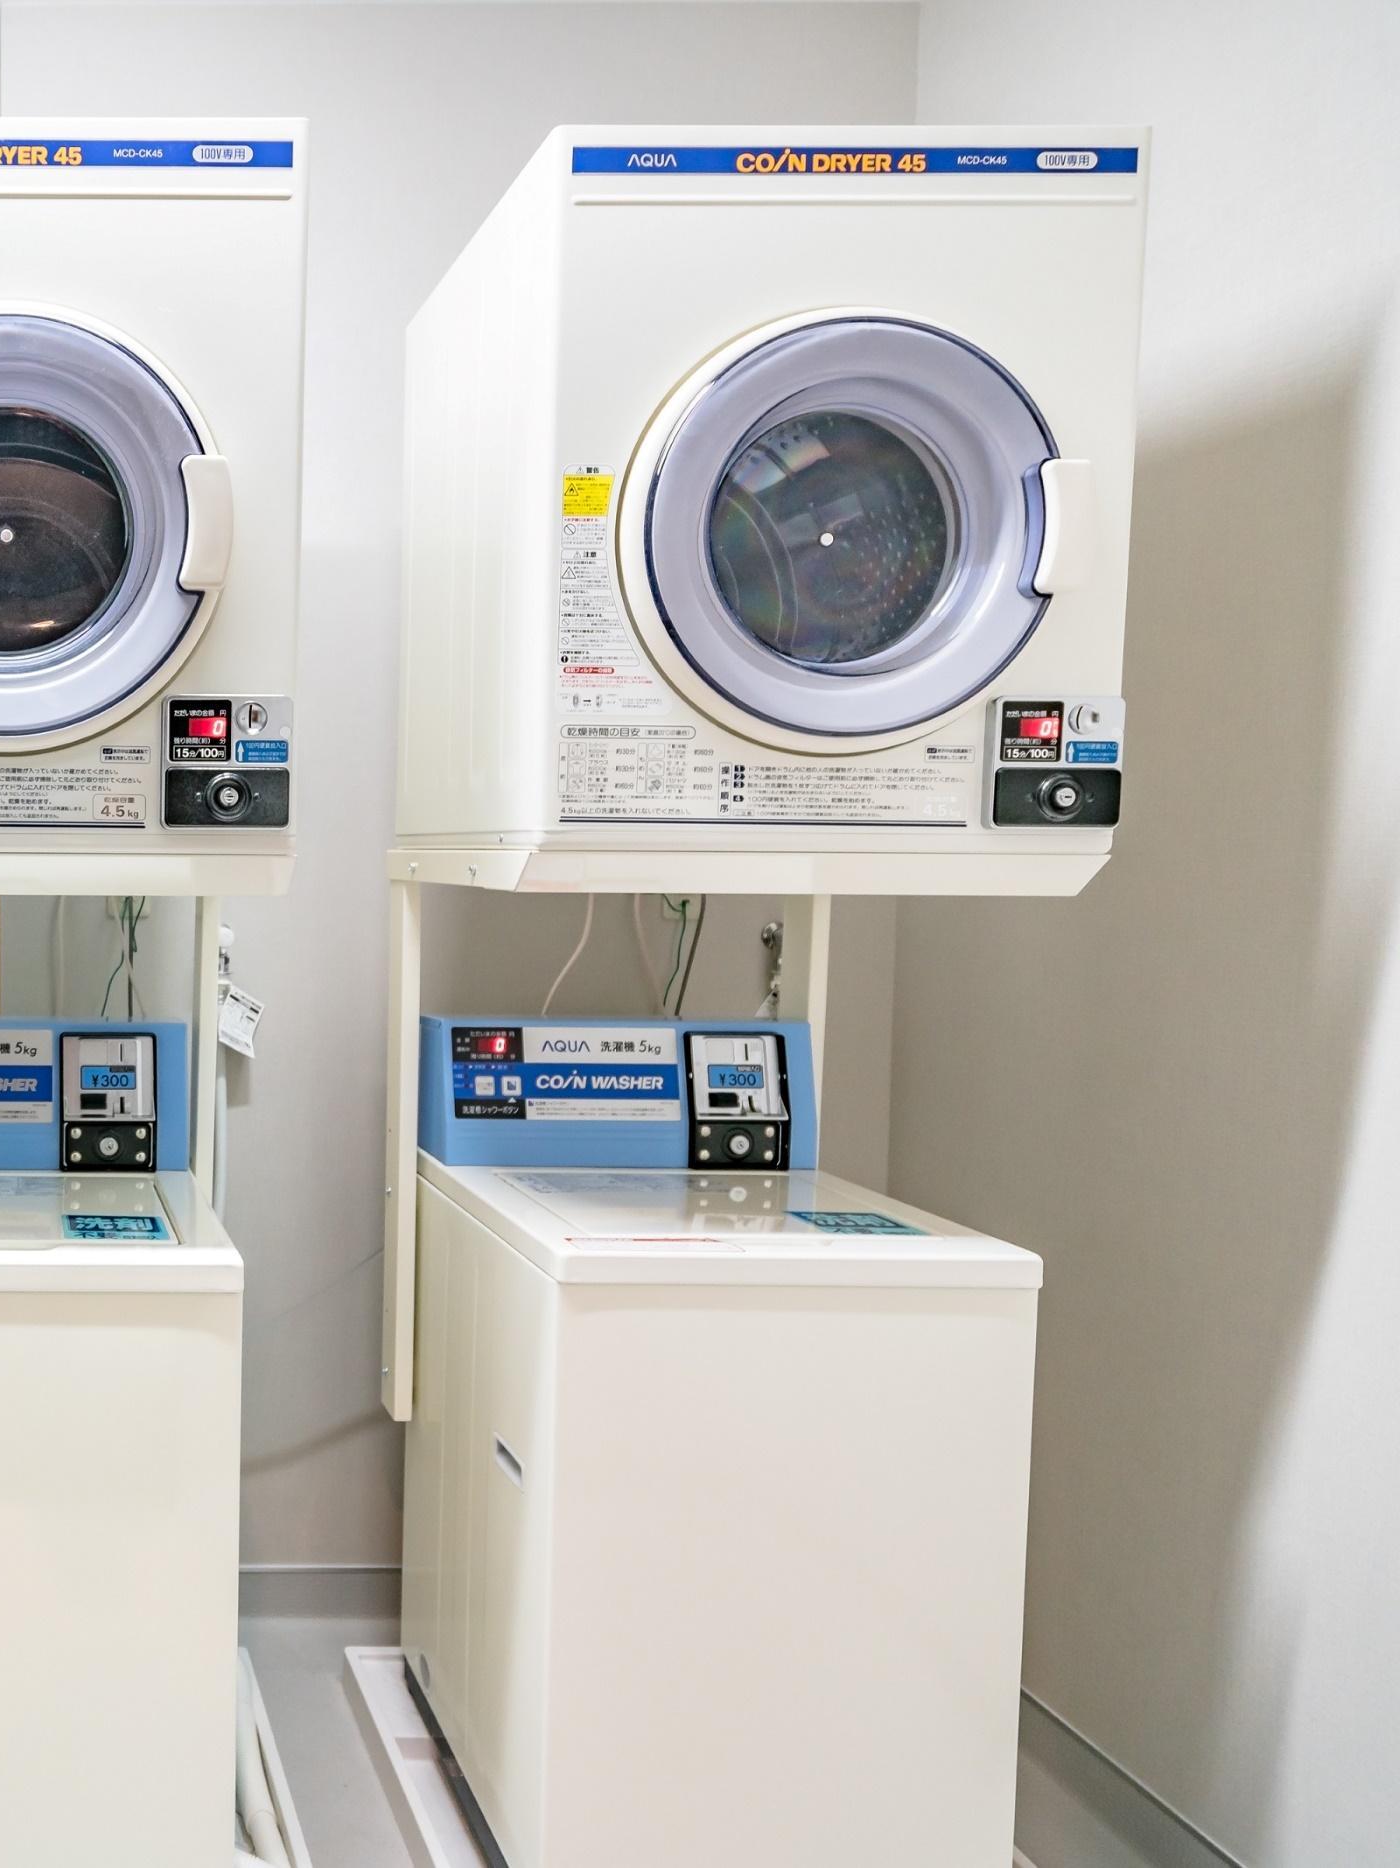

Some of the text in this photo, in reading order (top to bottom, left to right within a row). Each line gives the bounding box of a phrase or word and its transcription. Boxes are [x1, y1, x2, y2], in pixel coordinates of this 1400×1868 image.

[54, 147, 82, 165] 45
[113, 149, 162, 158] MCD-CK45
[200, 148, 246, 160] 100V専用
[628, 153, 677, 167] AQUA
[813, 154, 892, 172] DRYER
[898, 154, 926, 172] 45
[957, 156, 1007, 165] MCD-CK45
[1045, 155, 1090, 166] 100V専用
[213, 721, 224, 734] 0
[567, 728, 640, 736] 乾燥時間の目安
[1040, 722, 1051, 736] 0
[101, 806, 139, 819] 4.5 kg
[496, 1039, 505, 1052] 0
[542, 1040, 590, 1052] AQUA
[601, 1041, 635, 1052] 洗濯機
[92, 1075, 128, 1087] ¥300
[592, 1076, 664, 1090] WASHER
[719, 1073, 757, 1086] ¥300
[76, 1217, 153, 1230] 洗剤
